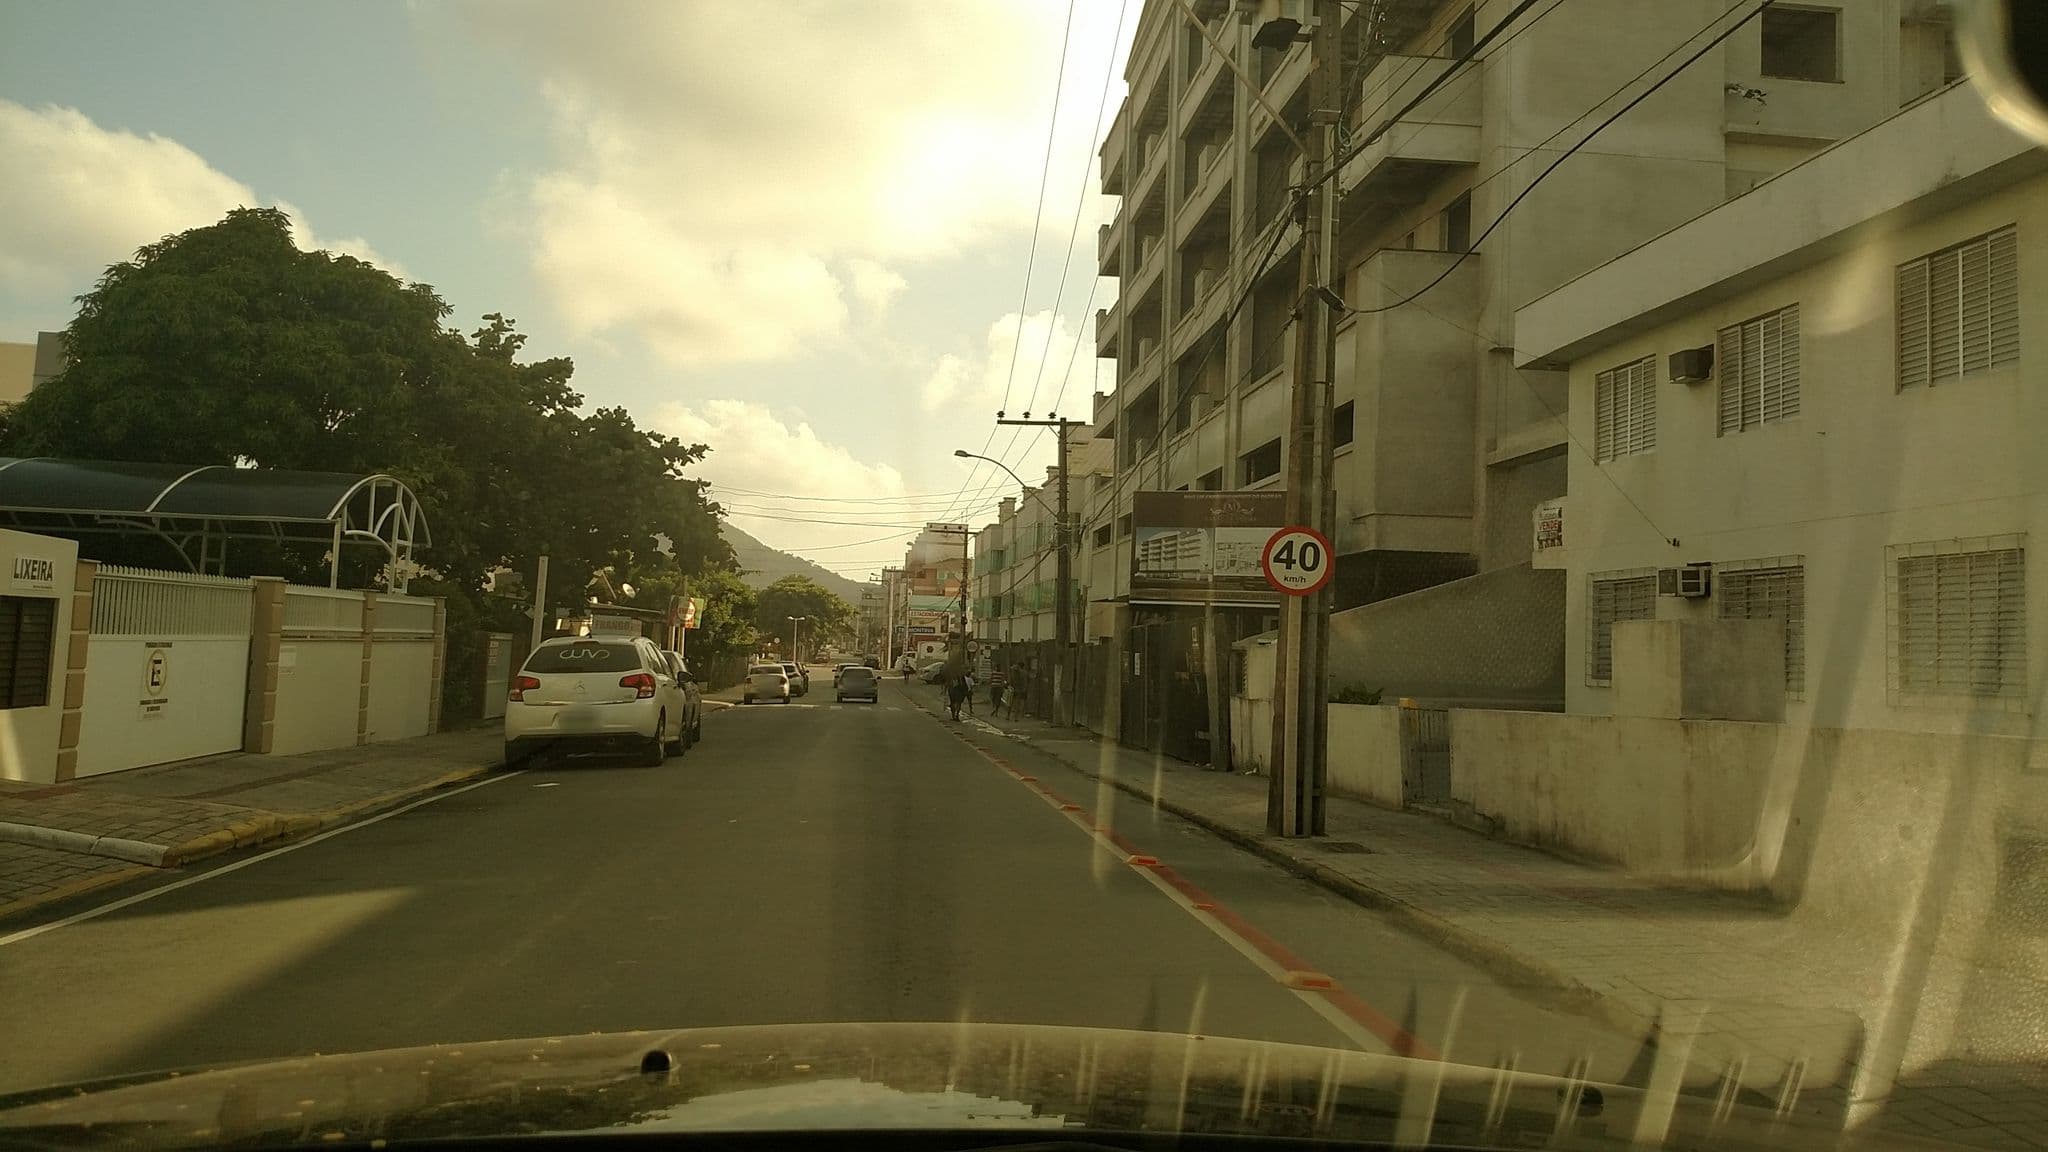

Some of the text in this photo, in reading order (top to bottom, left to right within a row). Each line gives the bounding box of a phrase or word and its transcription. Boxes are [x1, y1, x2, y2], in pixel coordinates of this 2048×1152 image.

[1273, 540, 1321, 572] 40
[14, 558, 53, 581] LIXEIRA
[1283, 575, 1307, 584] km/h
